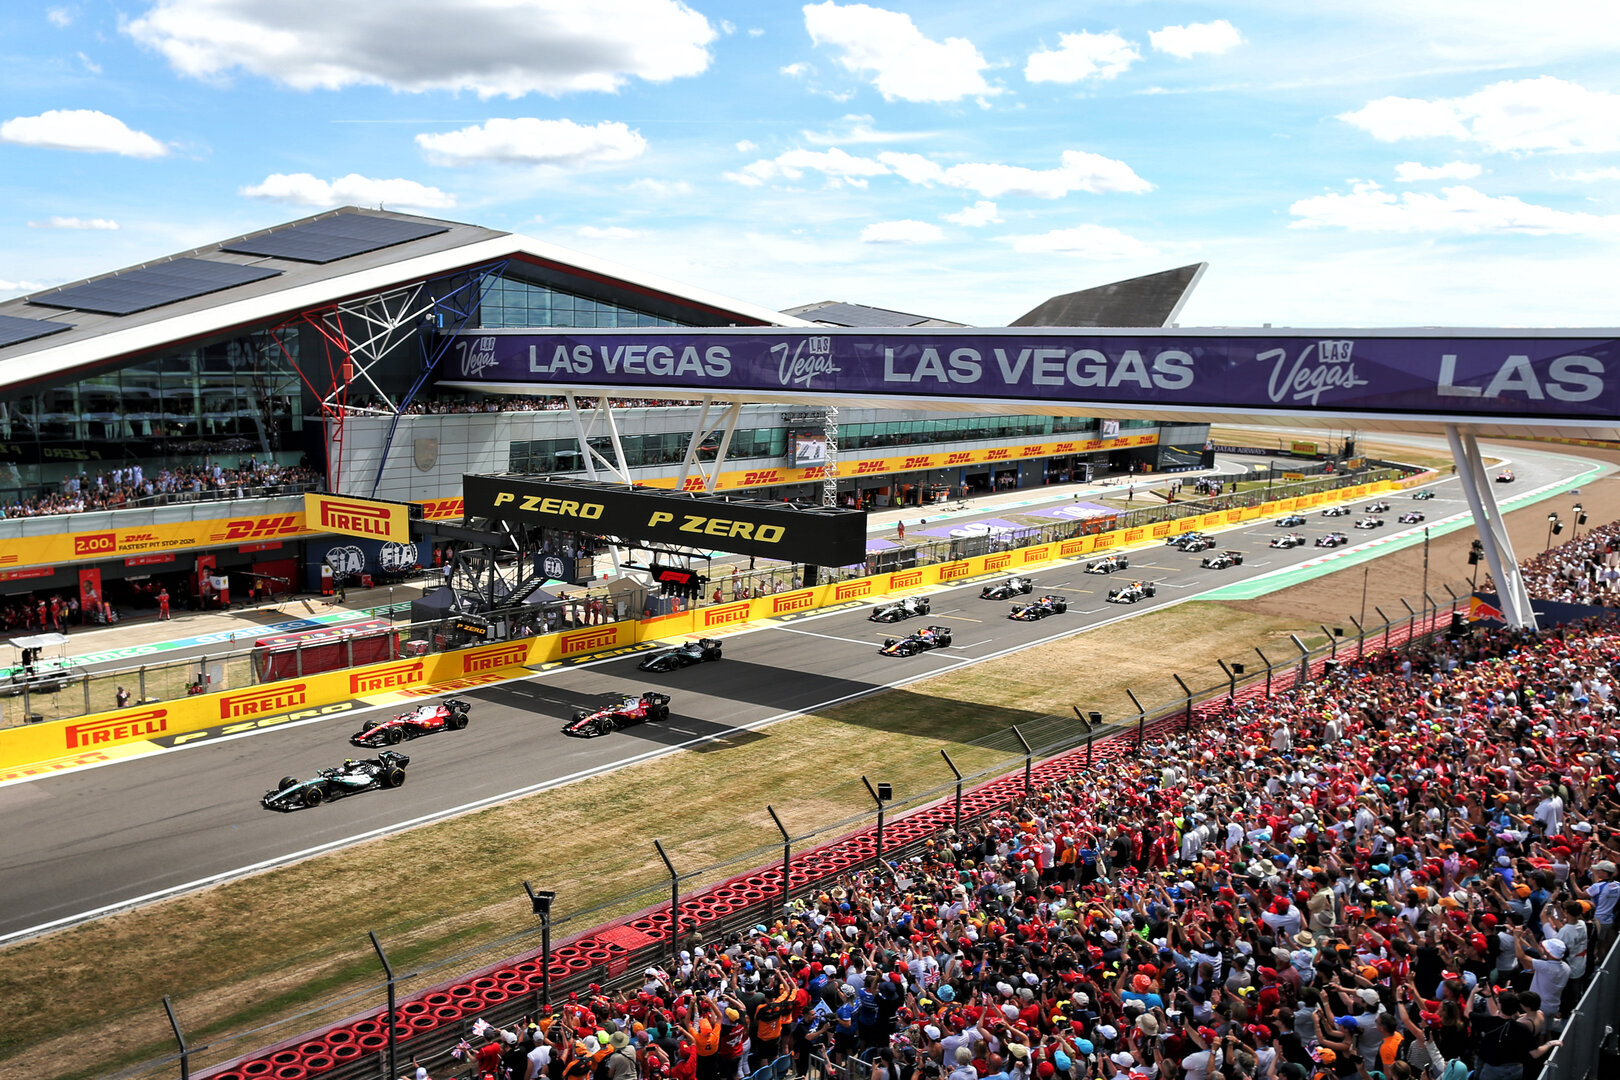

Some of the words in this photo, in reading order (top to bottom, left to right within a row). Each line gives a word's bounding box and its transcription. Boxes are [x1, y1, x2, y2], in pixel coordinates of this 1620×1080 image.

[481, 337, 496, 351] LAS
[809, 336, 830, 354] LAS
[1318, 340, 1354, 363] LAS
[456, 338, 499, 378] Vegas
[529, 345, 594, 374] LAS
[600, 345, 732, 378] VEGAS
[770, 339, 841, 388] Vegas
[884, 348, 982, 384] LAS
[994, 348, 1194, 389] VEGAS
[1256, 344, 1368, 406] Vegas
[1437, 354, 1605, 402] LAS
[948, 453, 970, 464] DHL
[987, 449, 1008, 460] DHL
[1237, 447, 1266, 455] AIRWAYS
[857, 461, 884, 473] DHL
[904, 457, 929, 469] DHL
[744, 471, 778, 485] DHL
[493, 492, 515, 507] P
[519, 495, 605, 520] ZERO
[225, 516, 299, 539] DHL
[320, 501, 391, 536] PIRELLI
[648, 511, 674, 527] P
[679, 515, 786, 543] ZERO
[119, 543, 147, 551] FASTEST
[124, 534, 153, 542] DHL
[1061, 541, 1083, 555] PIRELLI
[1094, 534, 1115, 548] PIRELLI
[984, 554, 1011, 571] PIRELLI
[1024, 547, 1049, 562] PIRELLI
[890, 571, 922, 589] PIRELLI
[940, 562, 969, 580] PIRELLI
[835, 581, 872, 600] PIRELLI
[773, 591, 813, 613] PIRELLI
[705, 603, 750, 626] PIRELLI
[464, 625, 486, 634] ZERO
[561, 627, 617, 654] PIRELLI
[464, 643, 527, 672] PIRELLI
[350, 662, 423, 694] PIRELLI
[220, 684, 306, 719] PIRELLI
[65, 709, 167, 749] PIRELLI
[173, 731, 208, 745] P
[221, 703, 352, 735] ZERO
